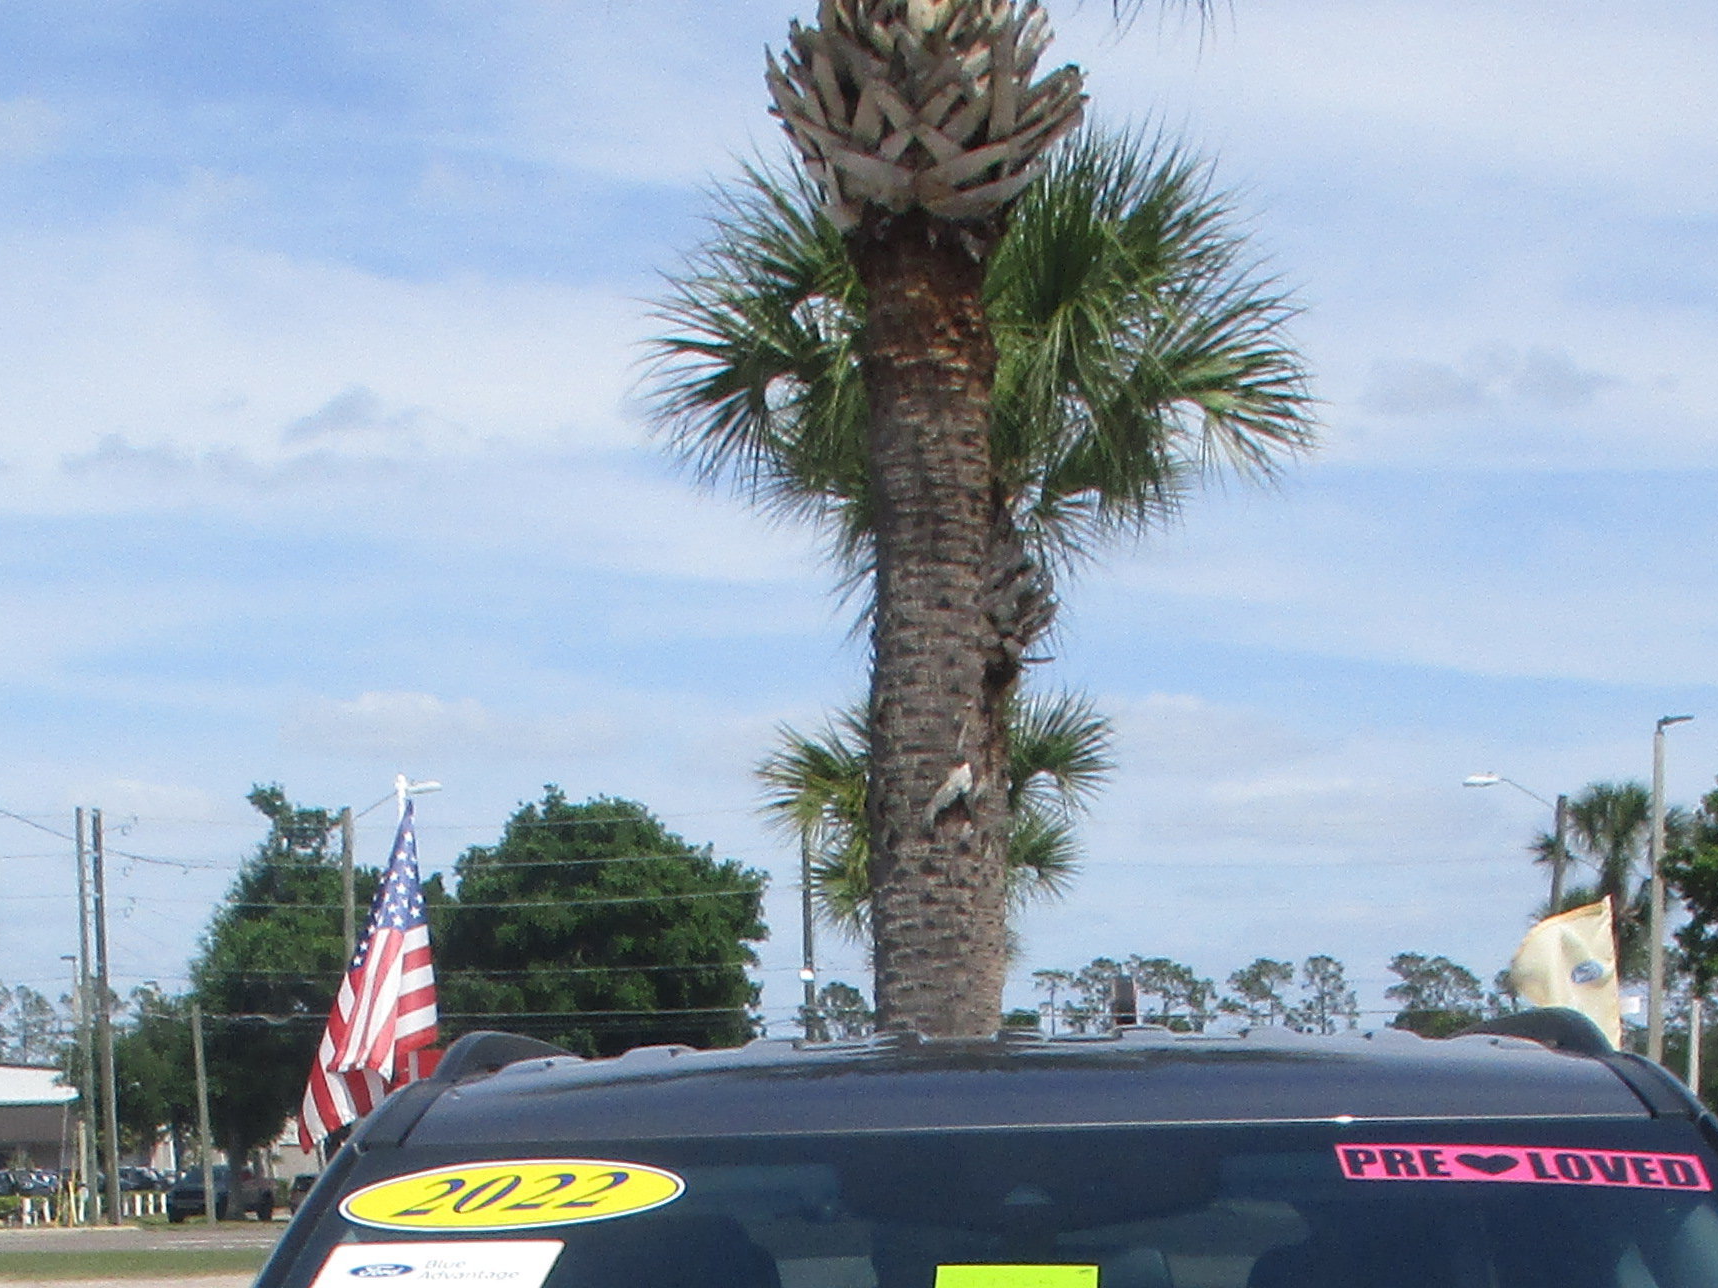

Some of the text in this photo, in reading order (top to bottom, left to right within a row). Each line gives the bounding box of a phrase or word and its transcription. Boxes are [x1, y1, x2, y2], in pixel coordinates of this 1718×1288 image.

[1344, 1147, 1701, 1188] PRE LOVED
[389, 1171, 630, 1218] 2022
[417, 1269, 521, 1281] Advantage
[424, 1259, 467, 1270] Blue
